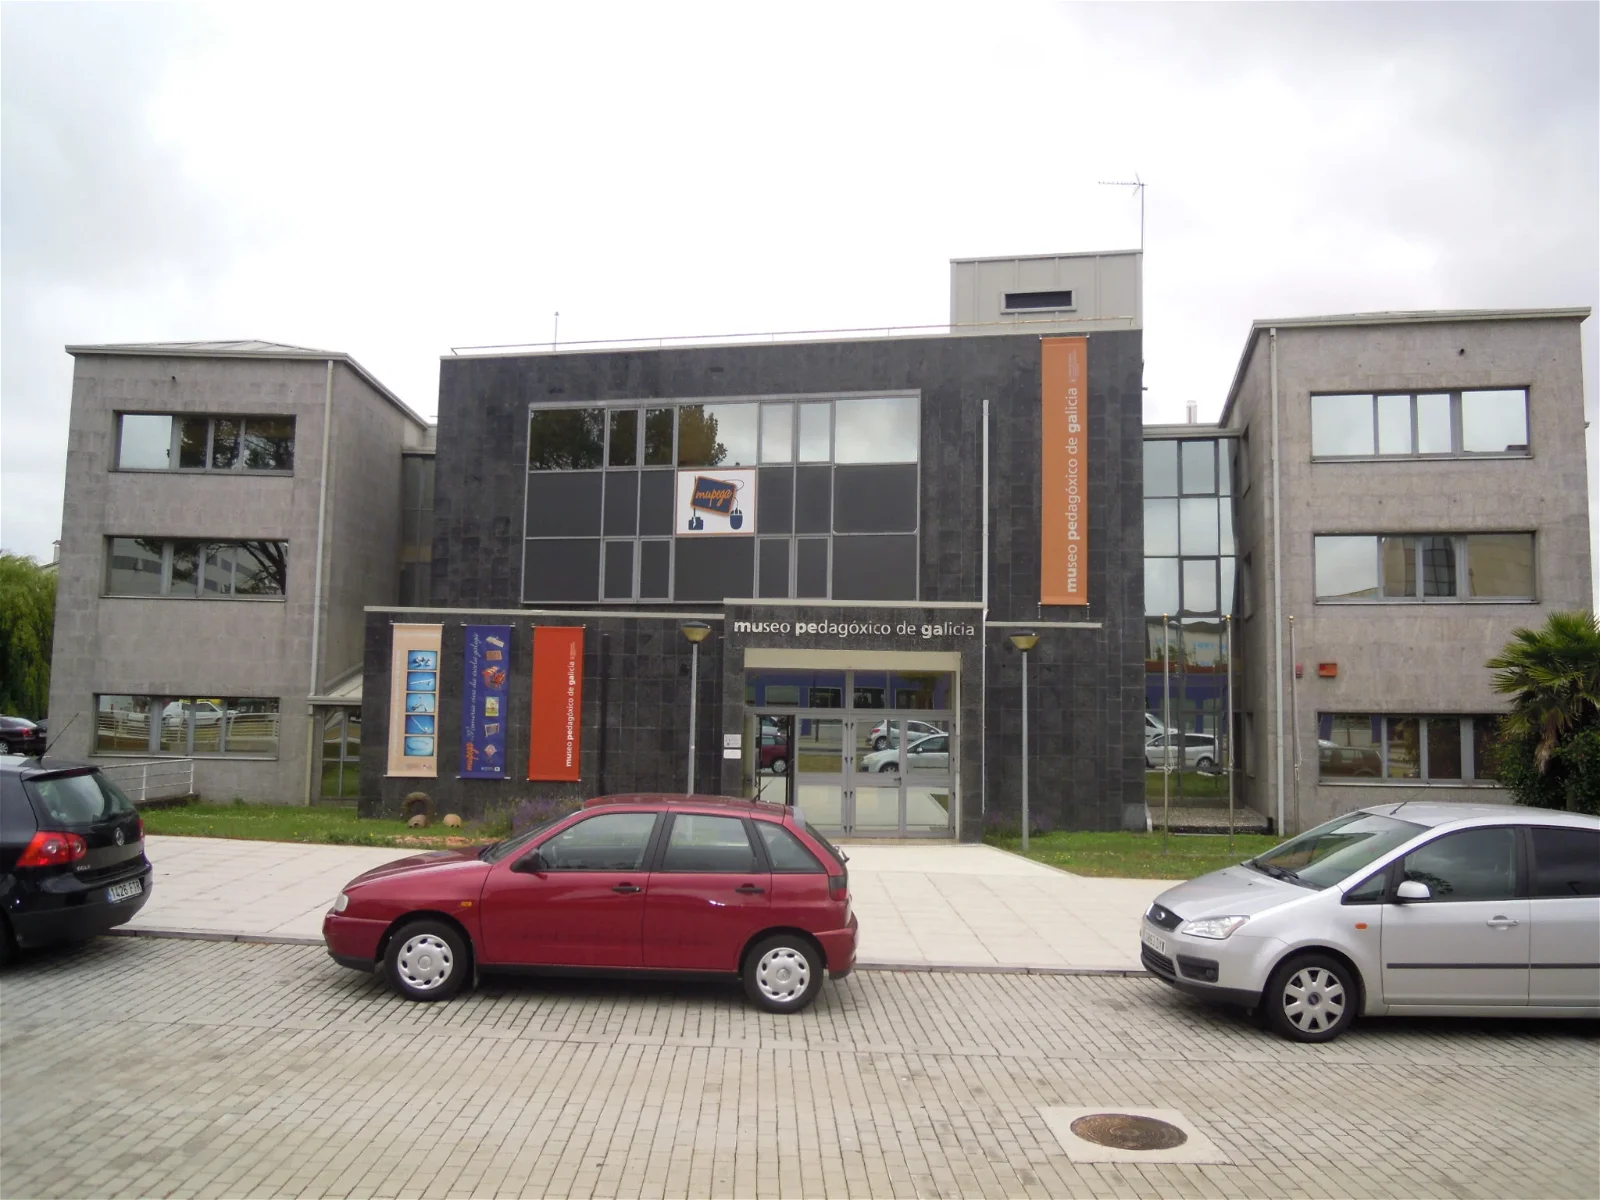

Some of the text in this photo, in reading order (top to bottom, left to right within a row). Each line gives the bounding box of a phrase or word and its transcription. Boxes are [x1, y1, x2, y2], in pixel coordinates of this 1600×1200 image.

[1065, 387, 1081, 433] galicia
[1065, 437, 1078, 455] de
[695, 488, 733, 508] mupega
[1065, 459, 1081, 540] pedagóxico
[1067, 544, 1078, 593] museo
[733, 619, 975, 639] museo pedagóxico de galicia
[567, 661, 576, 685] galicia
[567, 687, 575, 697] de
[566, 697, 575, 741] pedagóxico
[565, 742, 573, 767] museo
[110, 880, 141, 899] 1426 FTR
